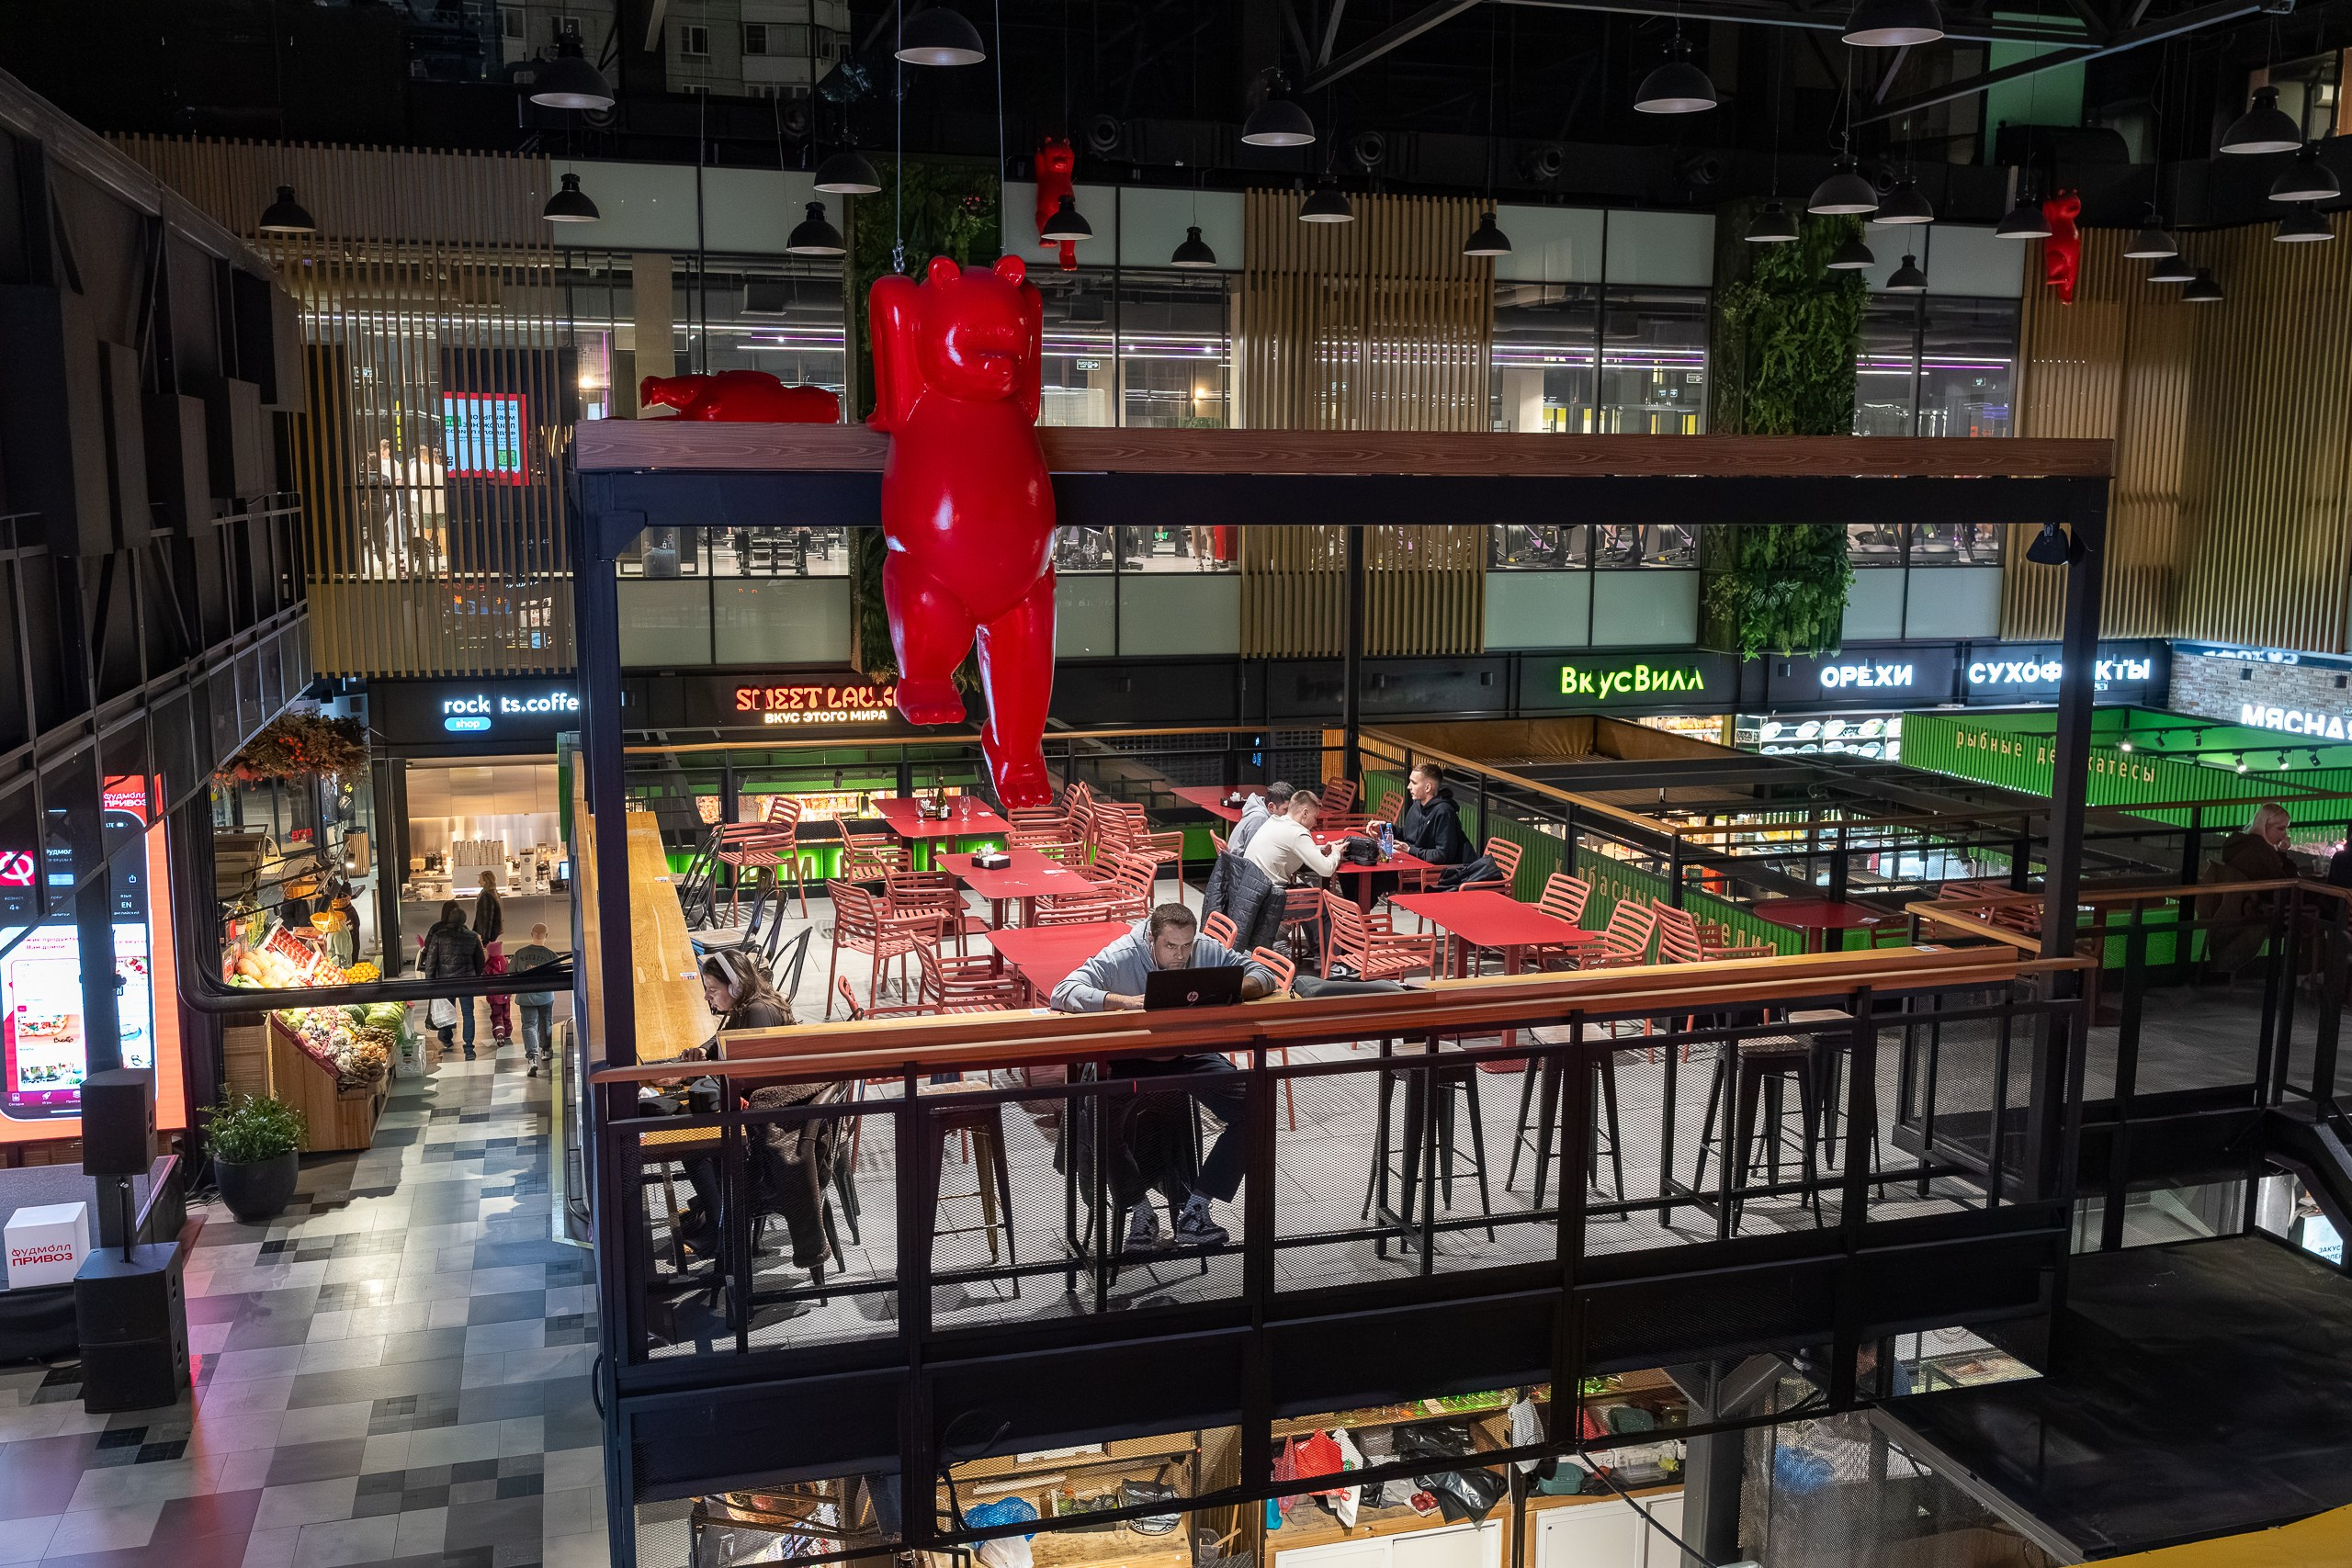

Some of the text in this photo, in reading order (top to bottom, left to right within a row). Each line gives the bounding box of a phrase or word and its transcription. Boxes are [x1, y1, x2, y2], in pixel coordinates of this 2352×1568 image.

[1820, 665, 1913, 687] ОРЕХИ
[1969, 659, 2150, 683] СУХОФКТЫ
[445, 693, 580, 714] rockts.coffe
[828, 686, 898, 708] LAVK
[455, 719, 481, 729] shop
[764, 710, 888, 724] ВКУС ЭТОГО МИРА
[1956, 730, 2154, 782] рыбные декатесы
[1555, 857, 1655, 908] клбасны
[12, 1252, 74, 1267] ПРИВОЗ
